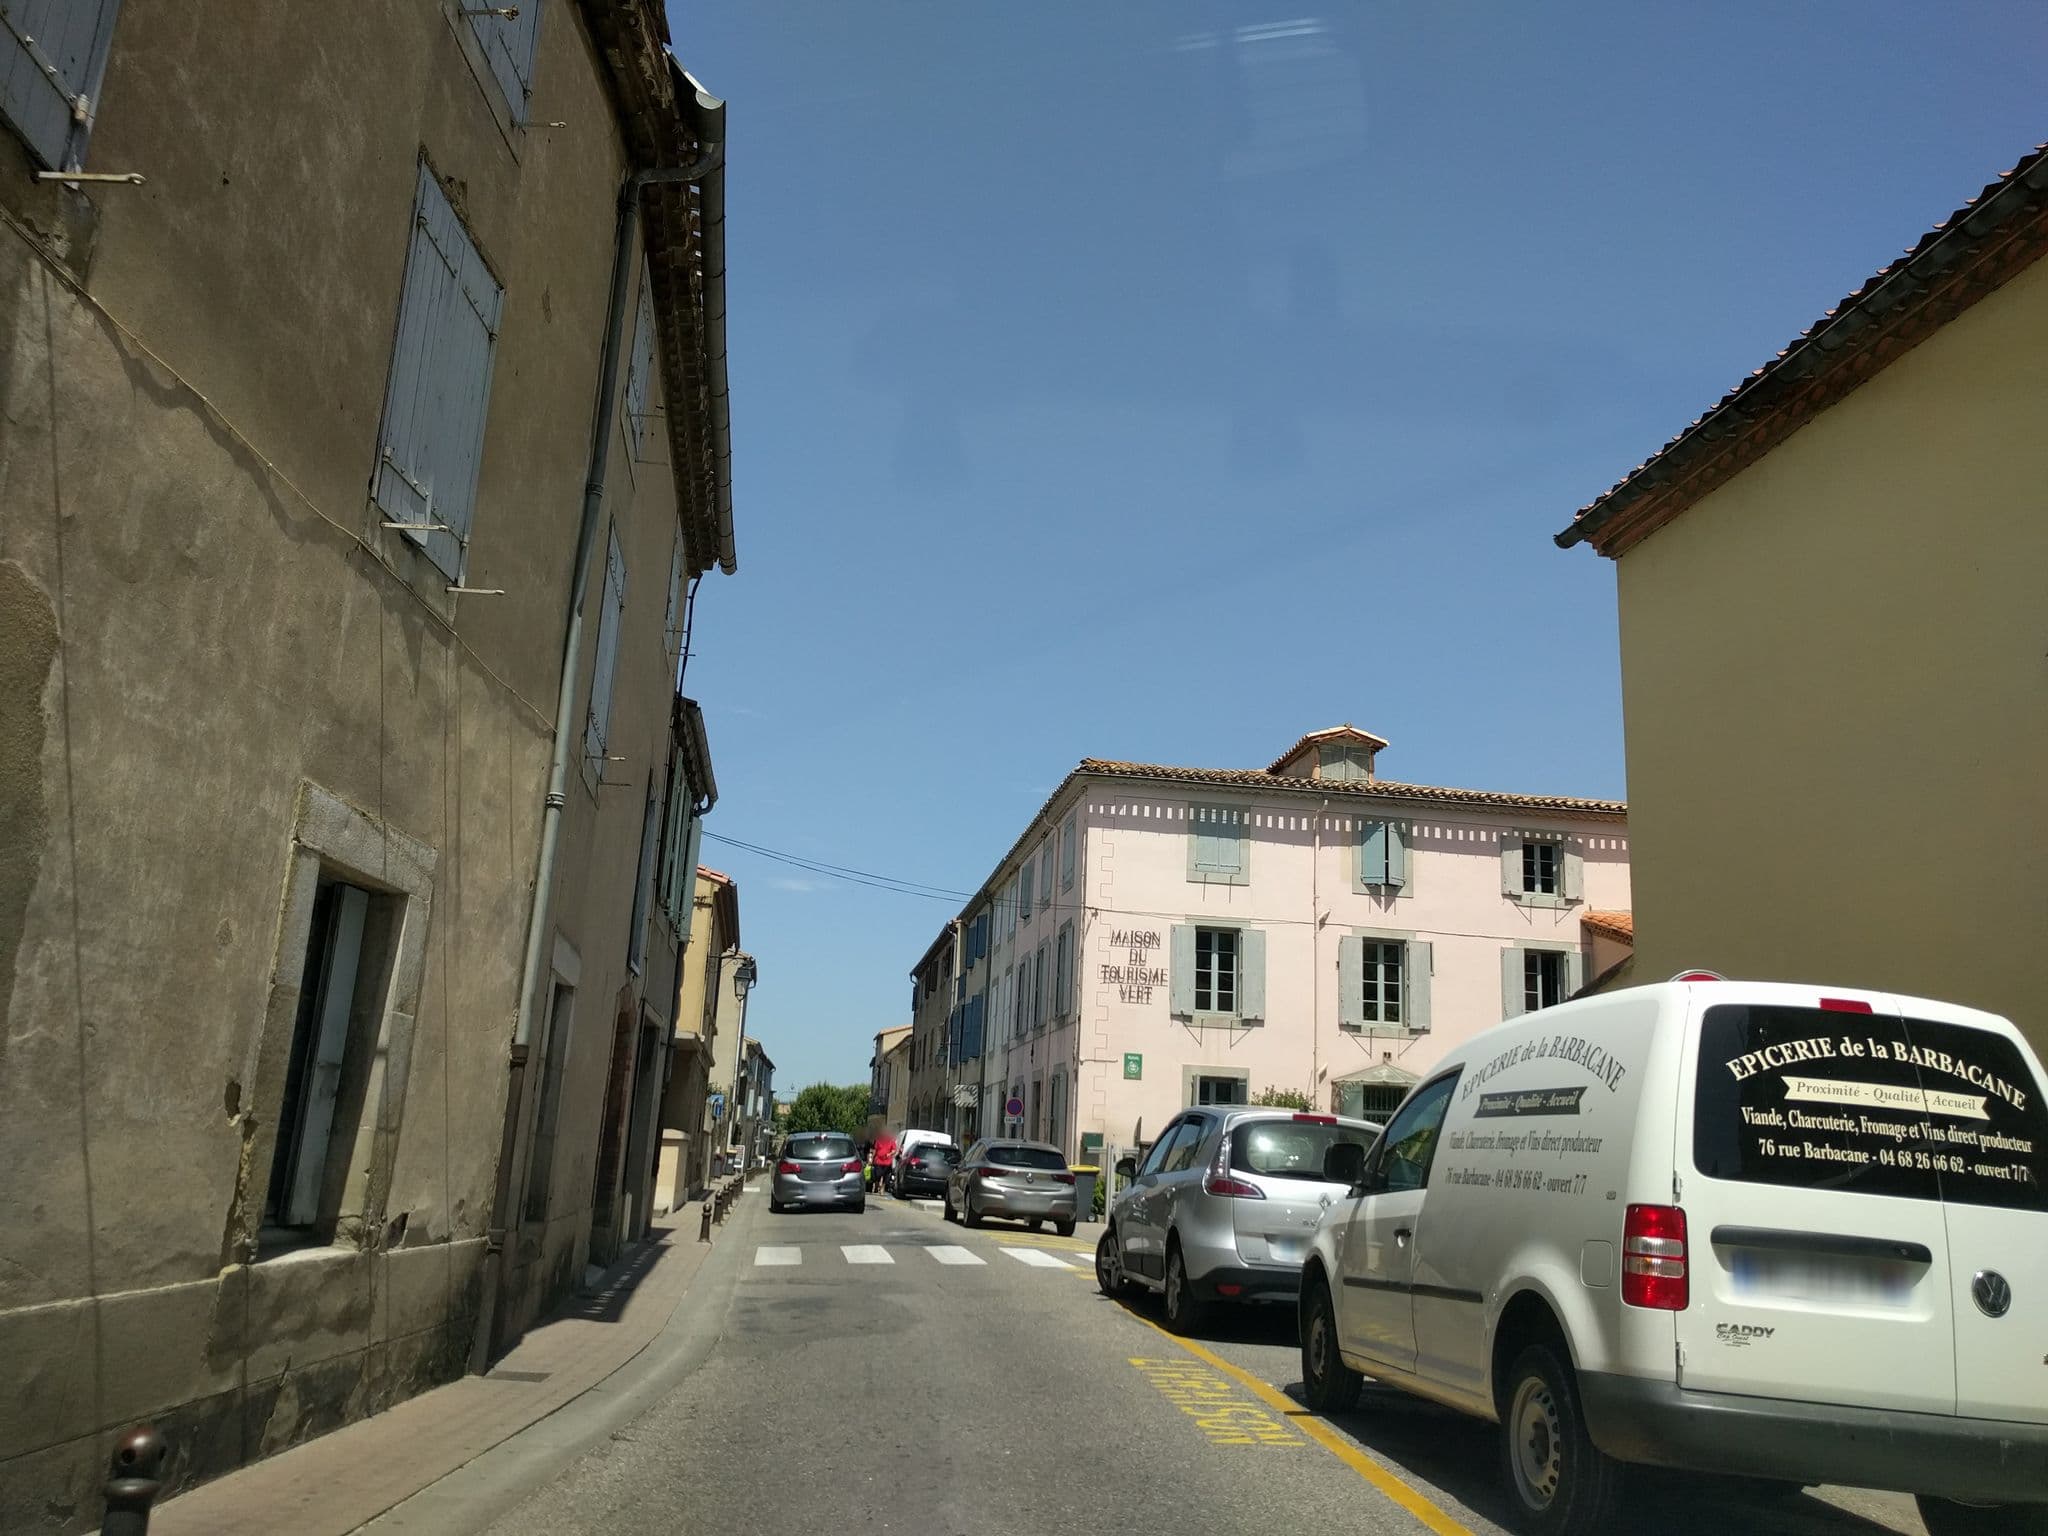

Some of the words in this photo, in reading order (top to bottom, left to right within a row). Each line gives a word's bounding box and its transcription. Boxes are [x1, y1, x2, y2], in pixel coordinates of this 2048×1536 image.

[1110, 929, 1160, 949] MAISON
[1129, 948, 1147, 966] DU
[1100, 964, 1168, 986] TOURISME
[1119, 984, 1152, 1004] VERT
[1462, 1045, 1522, 1101] EPICERIE
[1521, 1041, 1535, 1061] de
[1536, 1037, 1548, 1058] la
[1549, 1036, 1626, 1092] BARBACANE
[1726, 1037, 1836, 1081] EPICERIE
[1840, 1037, 1864, 1057] de
[1867, 1038, 1888, 1059] la
[1892, 1041, 2026, 1111] BARBACANE
[1547, 1091, 1578, 1107] Accueil
[1796, 1082, 1860, 1097] Proximité
[1873, 1088, 1920, 1103] Qualité
[1933, 1096, 1976, 1110] Accueil
[1741, 1106, 1787, 1130] Viande,
[1788, 1110, 1859, 1136] Charcuterie,
[1860, 1116, 1907, 1142] Fromage
[1909, 1126, 1919, 1138] et
[1920, 1122, 1945, 1142] Vins
[1948, 1125, 1978, 1145] direct
[1979, 1132, 2032, 1153] producteur
[1759, 1138, 1775, 1156] 76
[1778, 1145, 1800, 1157] rue
[1803, 1142, 1869, 1163] Barbacane
[1880, 1149, 1896, 1166] 04
[1898, 1150, 1913, 1168] 68
[1915, 1153, 1930, 1169] 26
[1932, 1155, 1948, 1171] 66
[1950, 1156, 1964, 1173] 62
[1975, 1163, 2011, 1180] ouvert
[2011, 1163, 2028, 1182] 7/7
[1547, 1178, 1572, 1194] ouvert
[1716, 1323, 1775, 1338] CADDY
